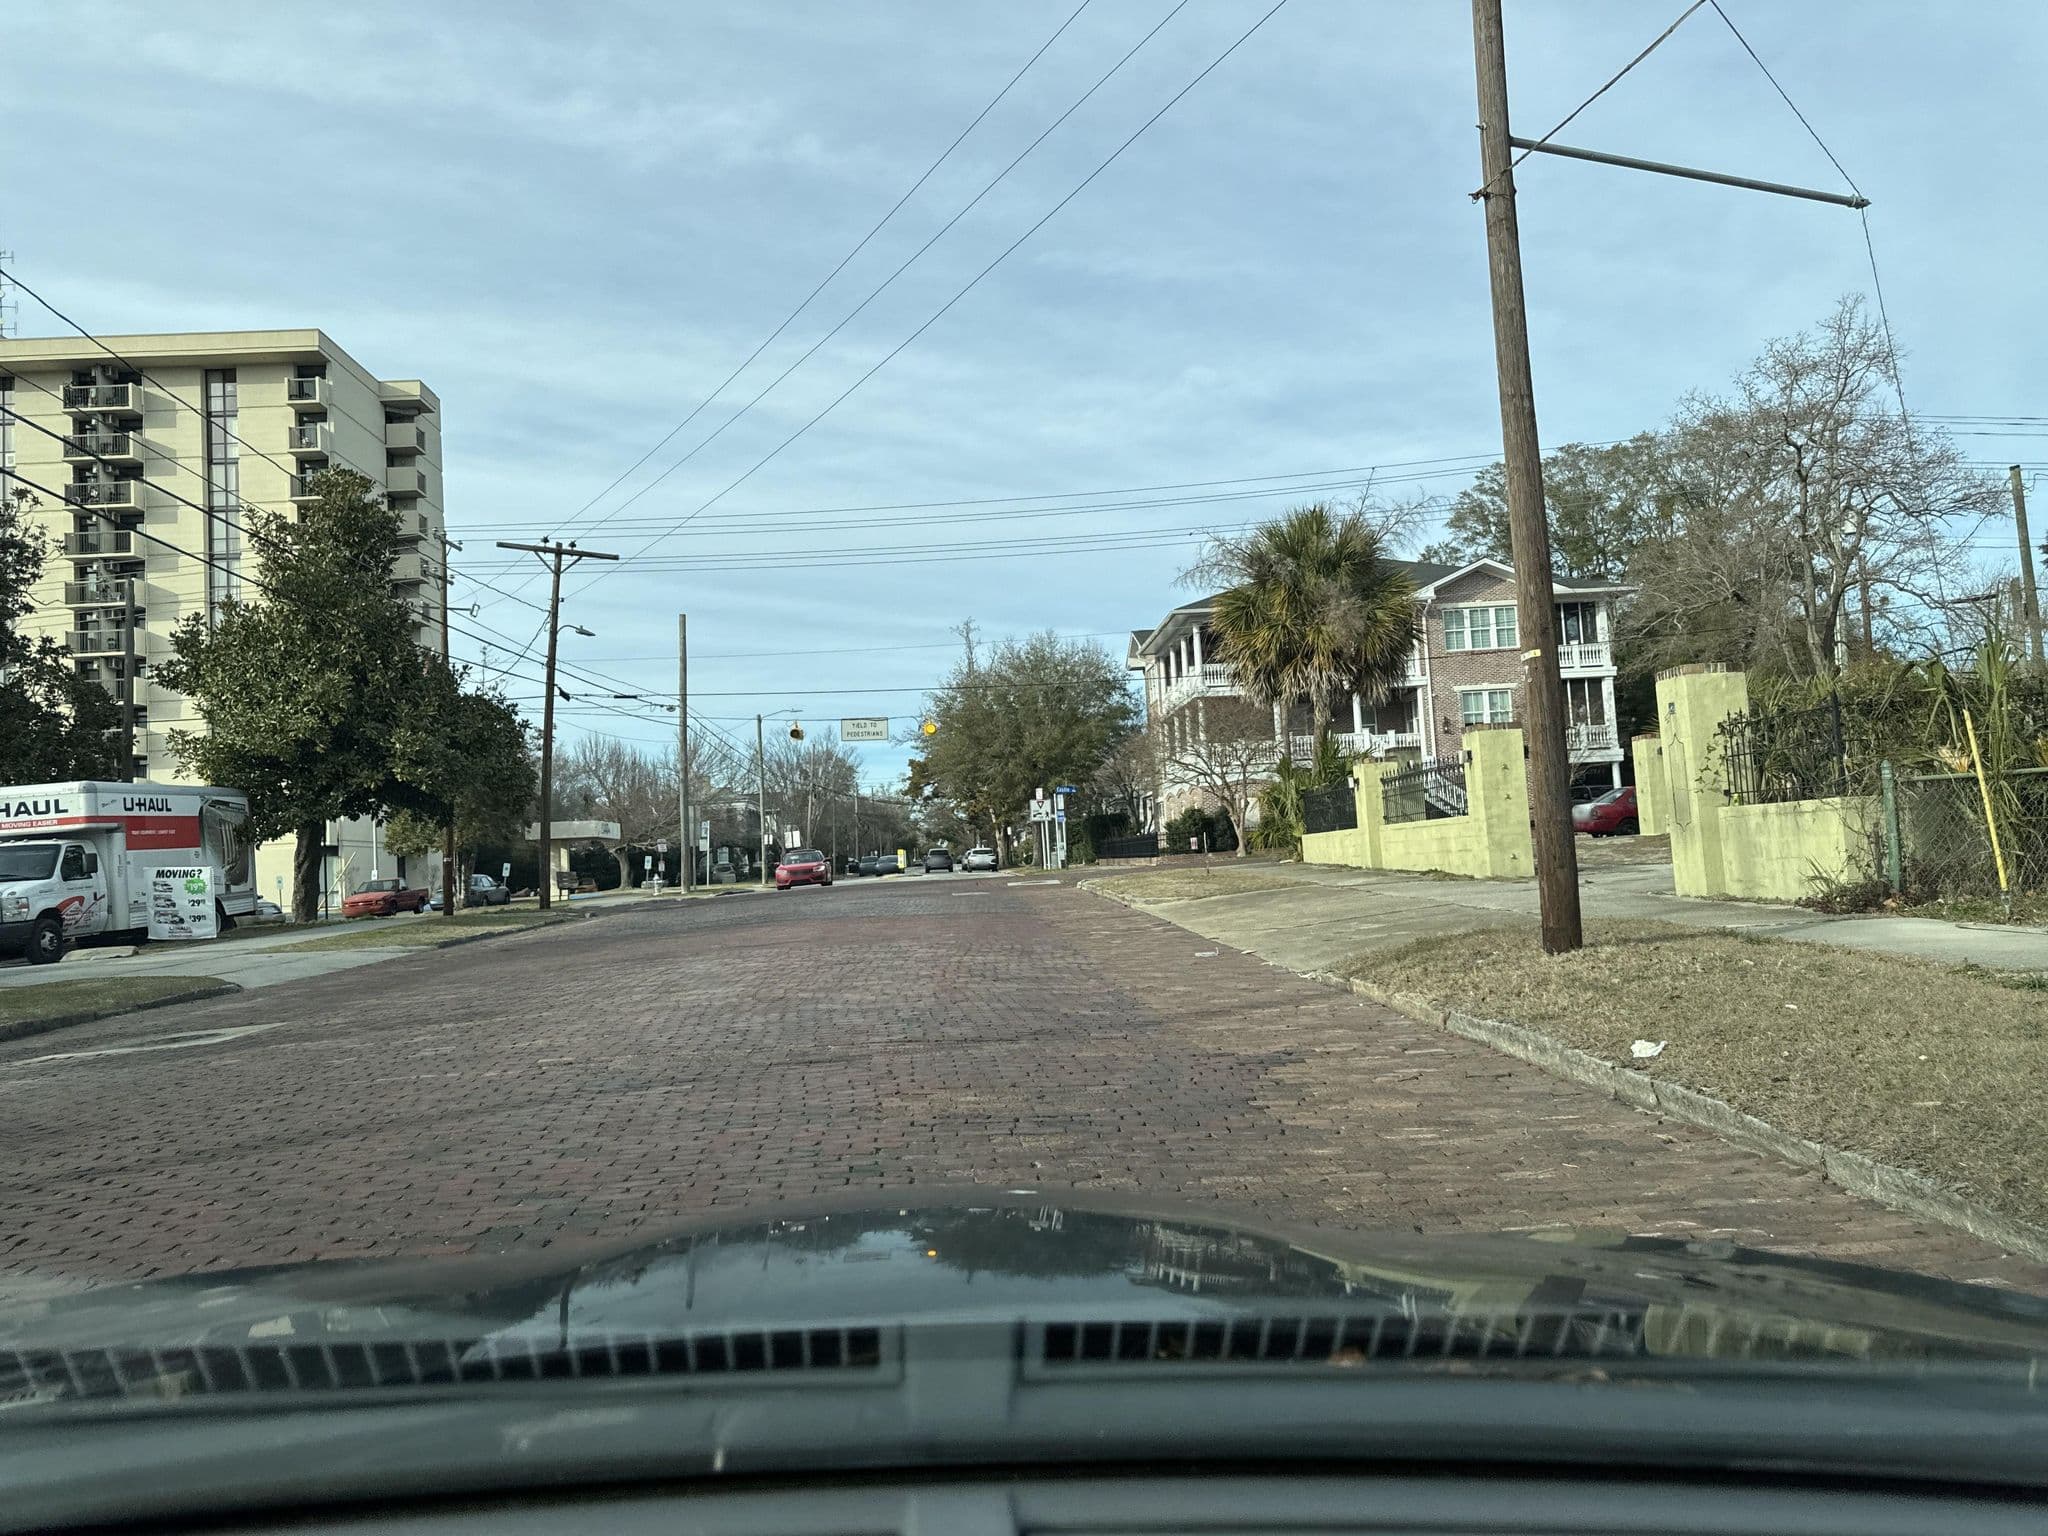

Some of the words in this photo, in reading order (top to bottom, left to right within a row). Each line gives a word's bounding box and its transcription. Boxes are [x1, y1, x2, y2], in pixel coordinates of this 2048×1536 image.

[852, 721, 867, 729] YIELD
[846, 730, 883, 738] PEDESTRIANS
[123, 797, 172, 812] U-HAUL
[32, 819, 58, 827] EASIER
[155, 868, 203, 879] MOVING?
